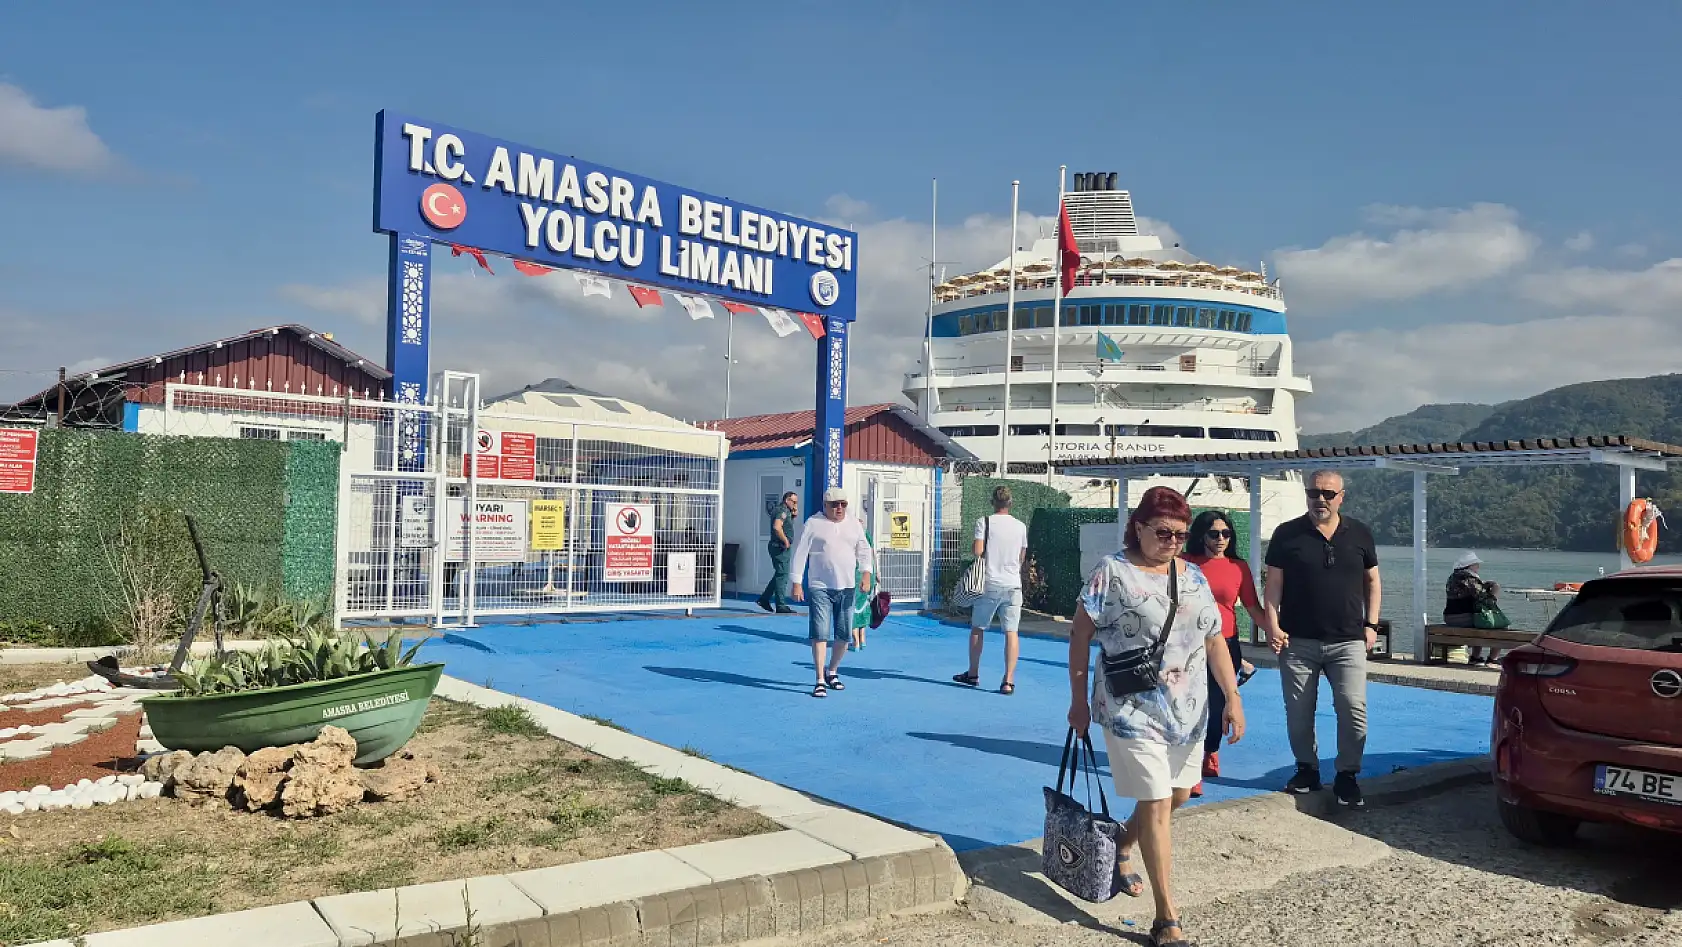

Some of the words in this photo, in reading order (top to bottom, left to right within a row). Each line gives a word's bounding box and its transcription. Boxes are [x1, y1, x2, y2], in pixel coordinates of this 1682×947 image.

[402, 122, 476, 184] T.C.
[482, 145, 663, 228] AMASRA
[519, 202, 644, 268] YOLCU
[1041, 442, 1100, 451] ASTORIA
[1549, 687, 1576, 695] CORSA
[323, 704, 357, 718] AMASRA
[1607, 768, 1636, 791] 74
[1641, 773, 1675, 797] BE
